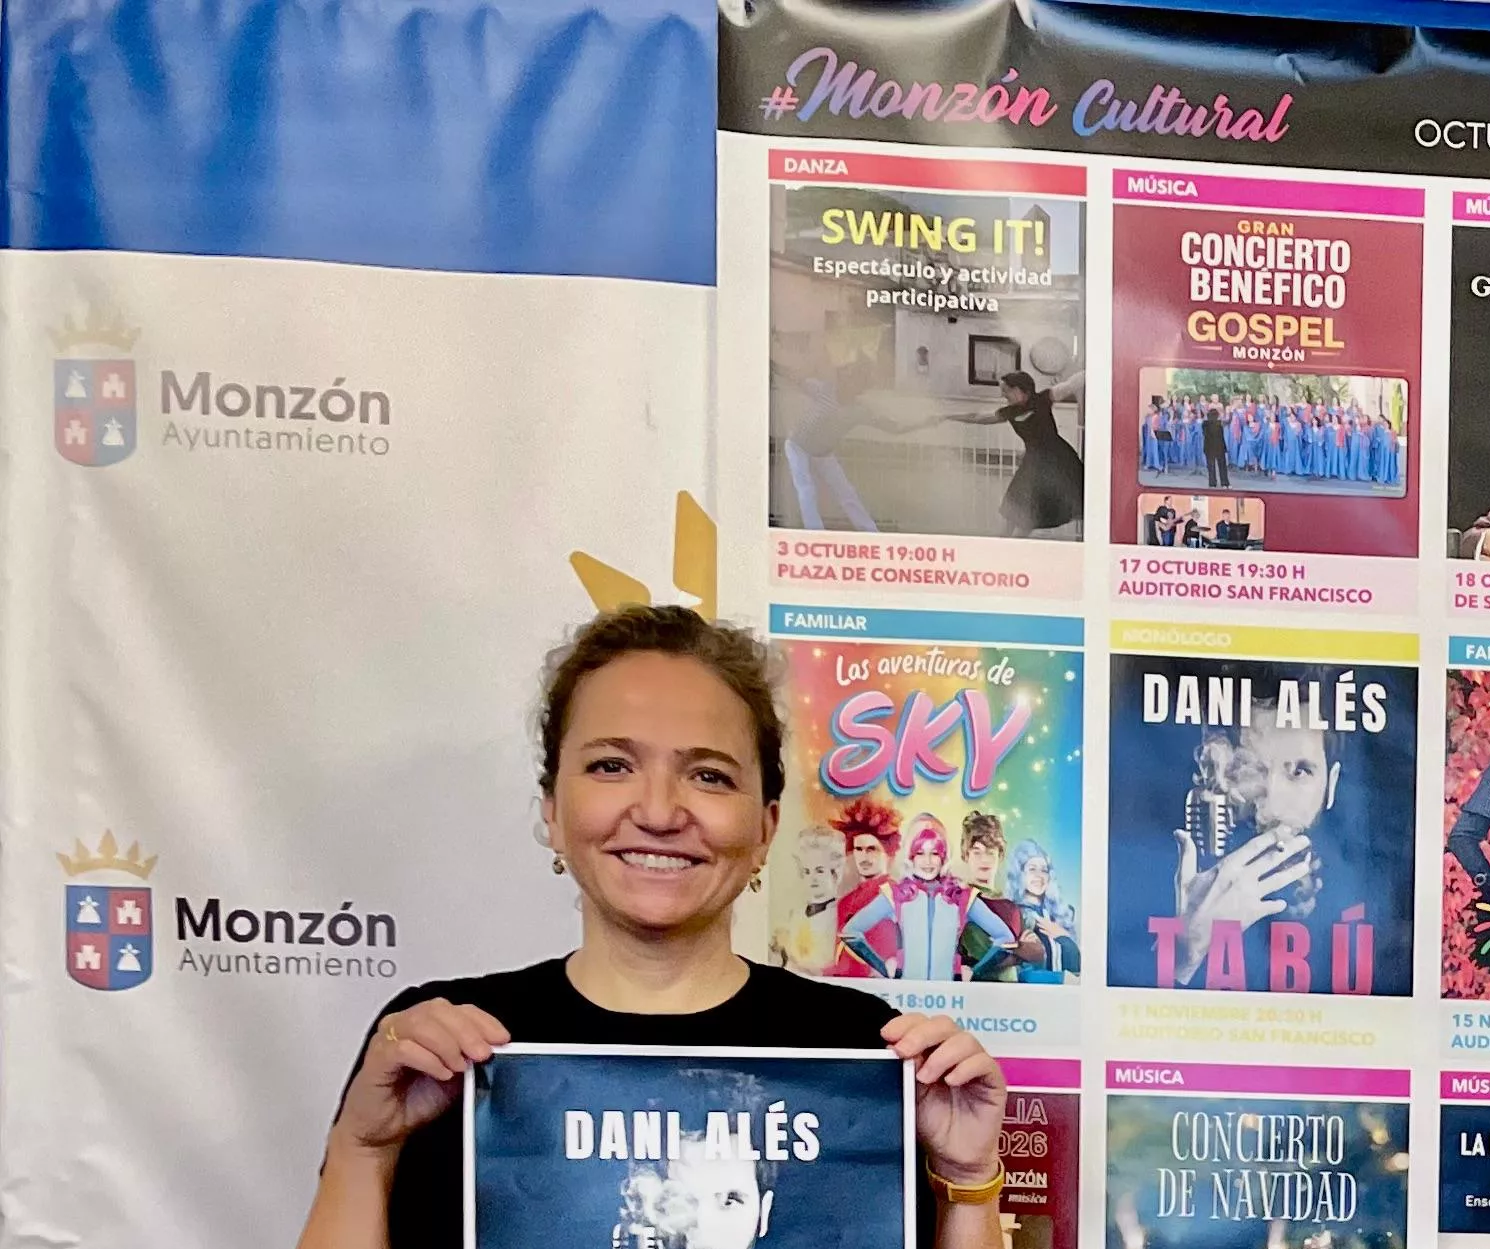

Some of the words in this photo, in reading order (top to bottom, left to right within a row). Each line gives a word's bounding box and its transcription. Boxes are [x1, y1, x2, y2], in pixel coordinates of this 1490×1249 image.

[762, 46, 1059, 126] #Monzón
[1073, 79, 1294, 143] Cultural
[784, 158, 848, 175] DANZA
[1128, 175, 1199, 197] MÚSICA
[821, 208, 977, 253] SWING
[992, 218, 1047, 256] IT!
[1237, 220, 1295, 236] GRAN
[813, 257, 935, 283] Espectáculo
[940, 266, 953, 284] y
[958, 264, 1052, 286] actividad
[1181, 232, 1351, 274] CONCIERTO
[866, 287, 999, 314] participativa
[1189, 260, 1345, 309] BENÉFICO
[1187, 311, 1344, 349] GOSPEL
[1232, 343, 1305, 362] MONZÓN
[161, 369, 391, 425] Monzón
[162, 423, 391, 457] Ayuntamiento
[1119, 559, 1143, 574] 17
[1146, 559, 1232, 578] OCTUBRE
[1237, 562, 1286, 579] 19:30
[1291, 565, 1306, 580] H
[1118, 579, 1222, 599] AUDITORIO
[1227, 583, 1264, 601] SAN
[1268, 585, 1372, 604] FRANCISCO
[785, 613, 867, 632] FAMILIAR
[836, 655, 870, 684] Las
[877, 647, 981, 679] aventuras
[988, 656, 1015, 686] de
[1143, 673, 1252, 727] DANI
[1275, 670, 1387, 732] ALÉS
[819, 687, 1033, 799] SKY
[175, 896, 397, 948] Monzón
[177, 948, 398, 979] Ayuntamiento
[1148, 902, 1374, 997] TABÚ
[564, 1110, 681, 1161] DANI
[704, 1099, 820, 1162] ALÉS
[1171, 1112, 1345, 1170] CONCIERTO
[1460, 1132, 1486, 1156] LA
[1157, 1168, 1195, 1218] DE
[1210, 1171, 1357, 1223] NAVIDAD
